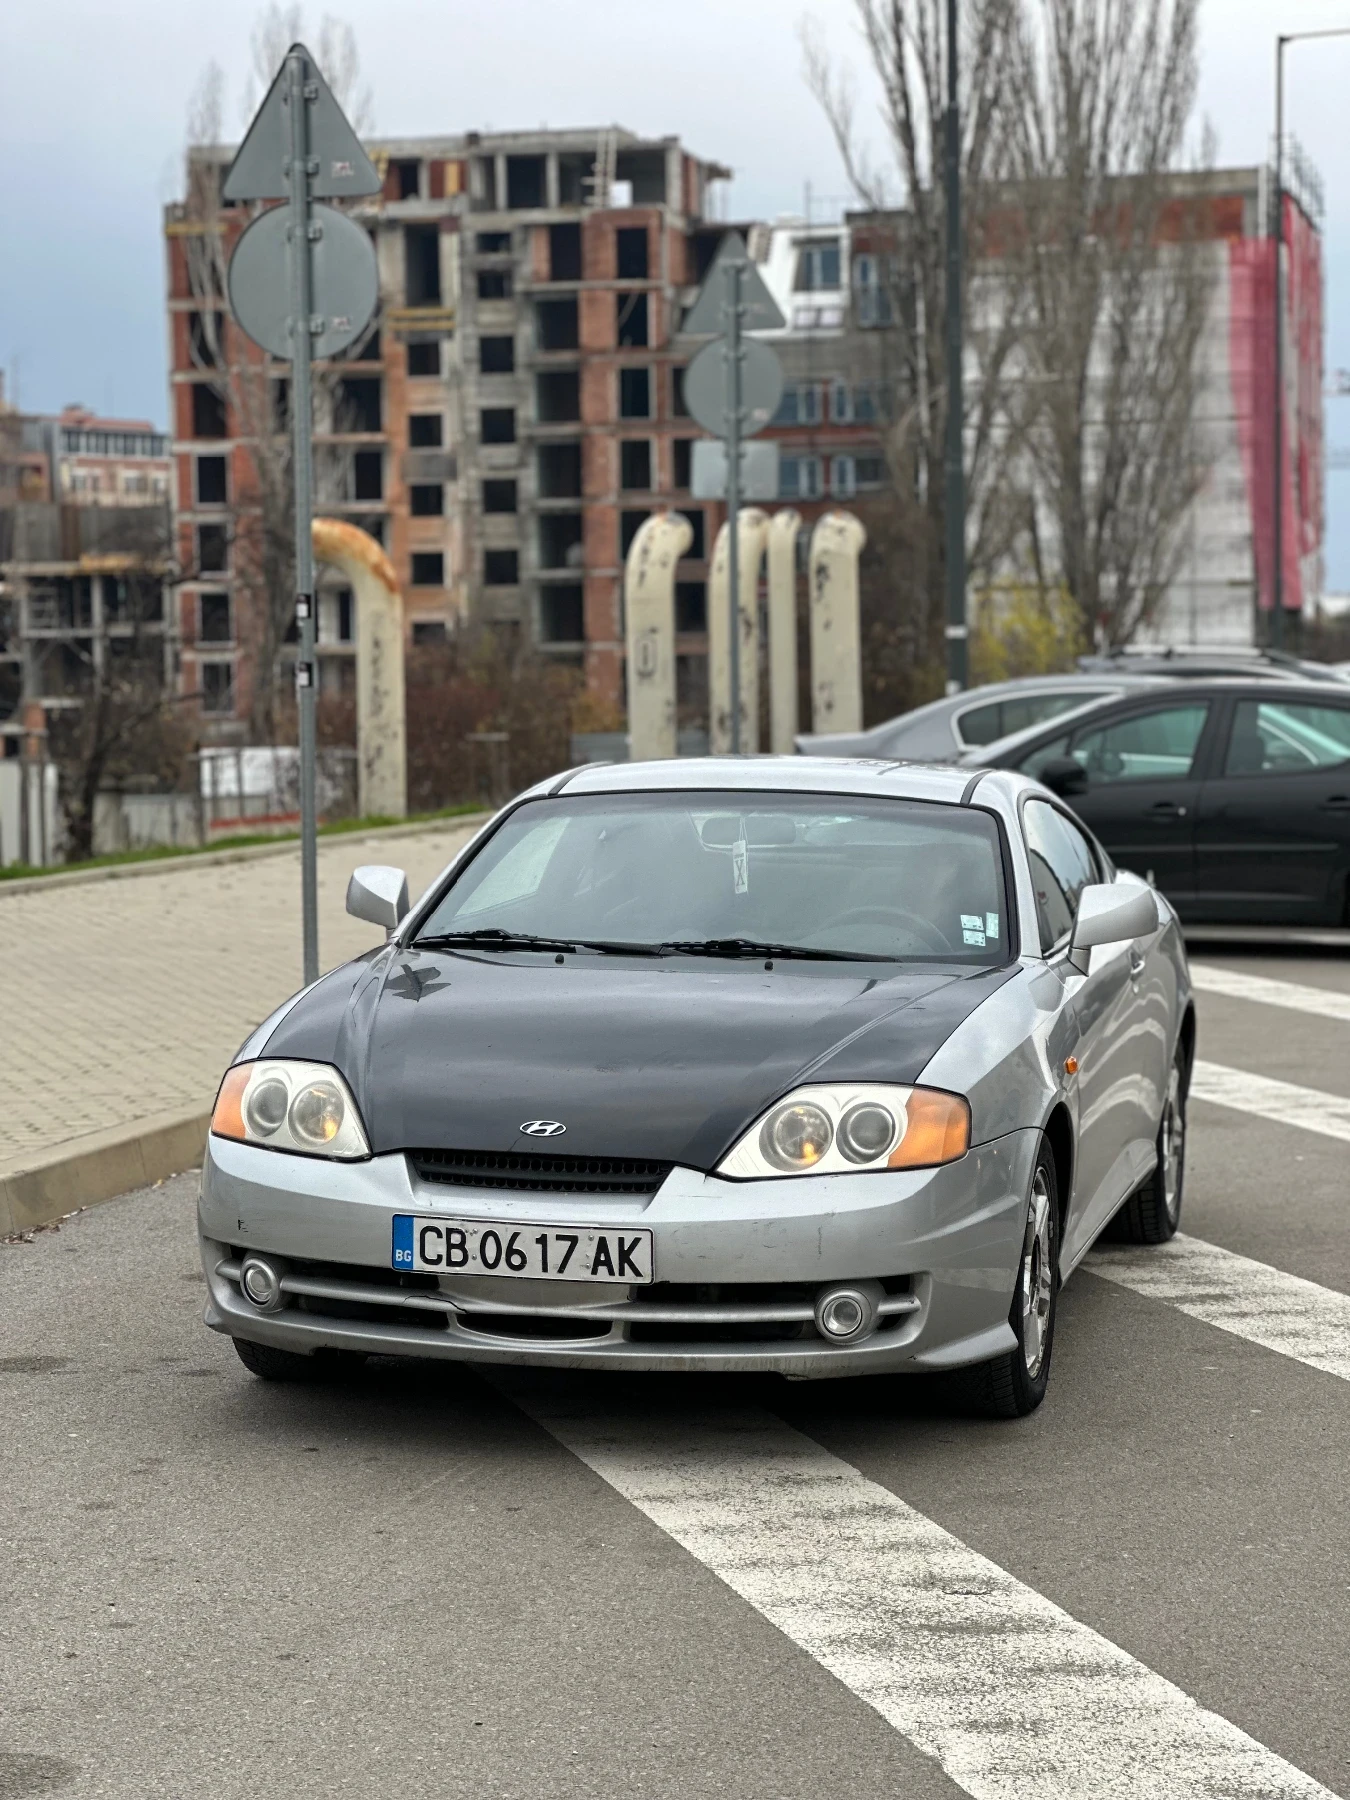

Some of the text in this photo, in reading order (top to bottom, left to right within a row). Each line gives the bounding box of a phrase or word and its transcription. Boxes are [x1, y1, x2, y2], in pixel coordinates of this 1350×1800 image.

[395, 1249, 412, 1262] BG
[419, 1225, 644, 1278] CB 0617 AK
